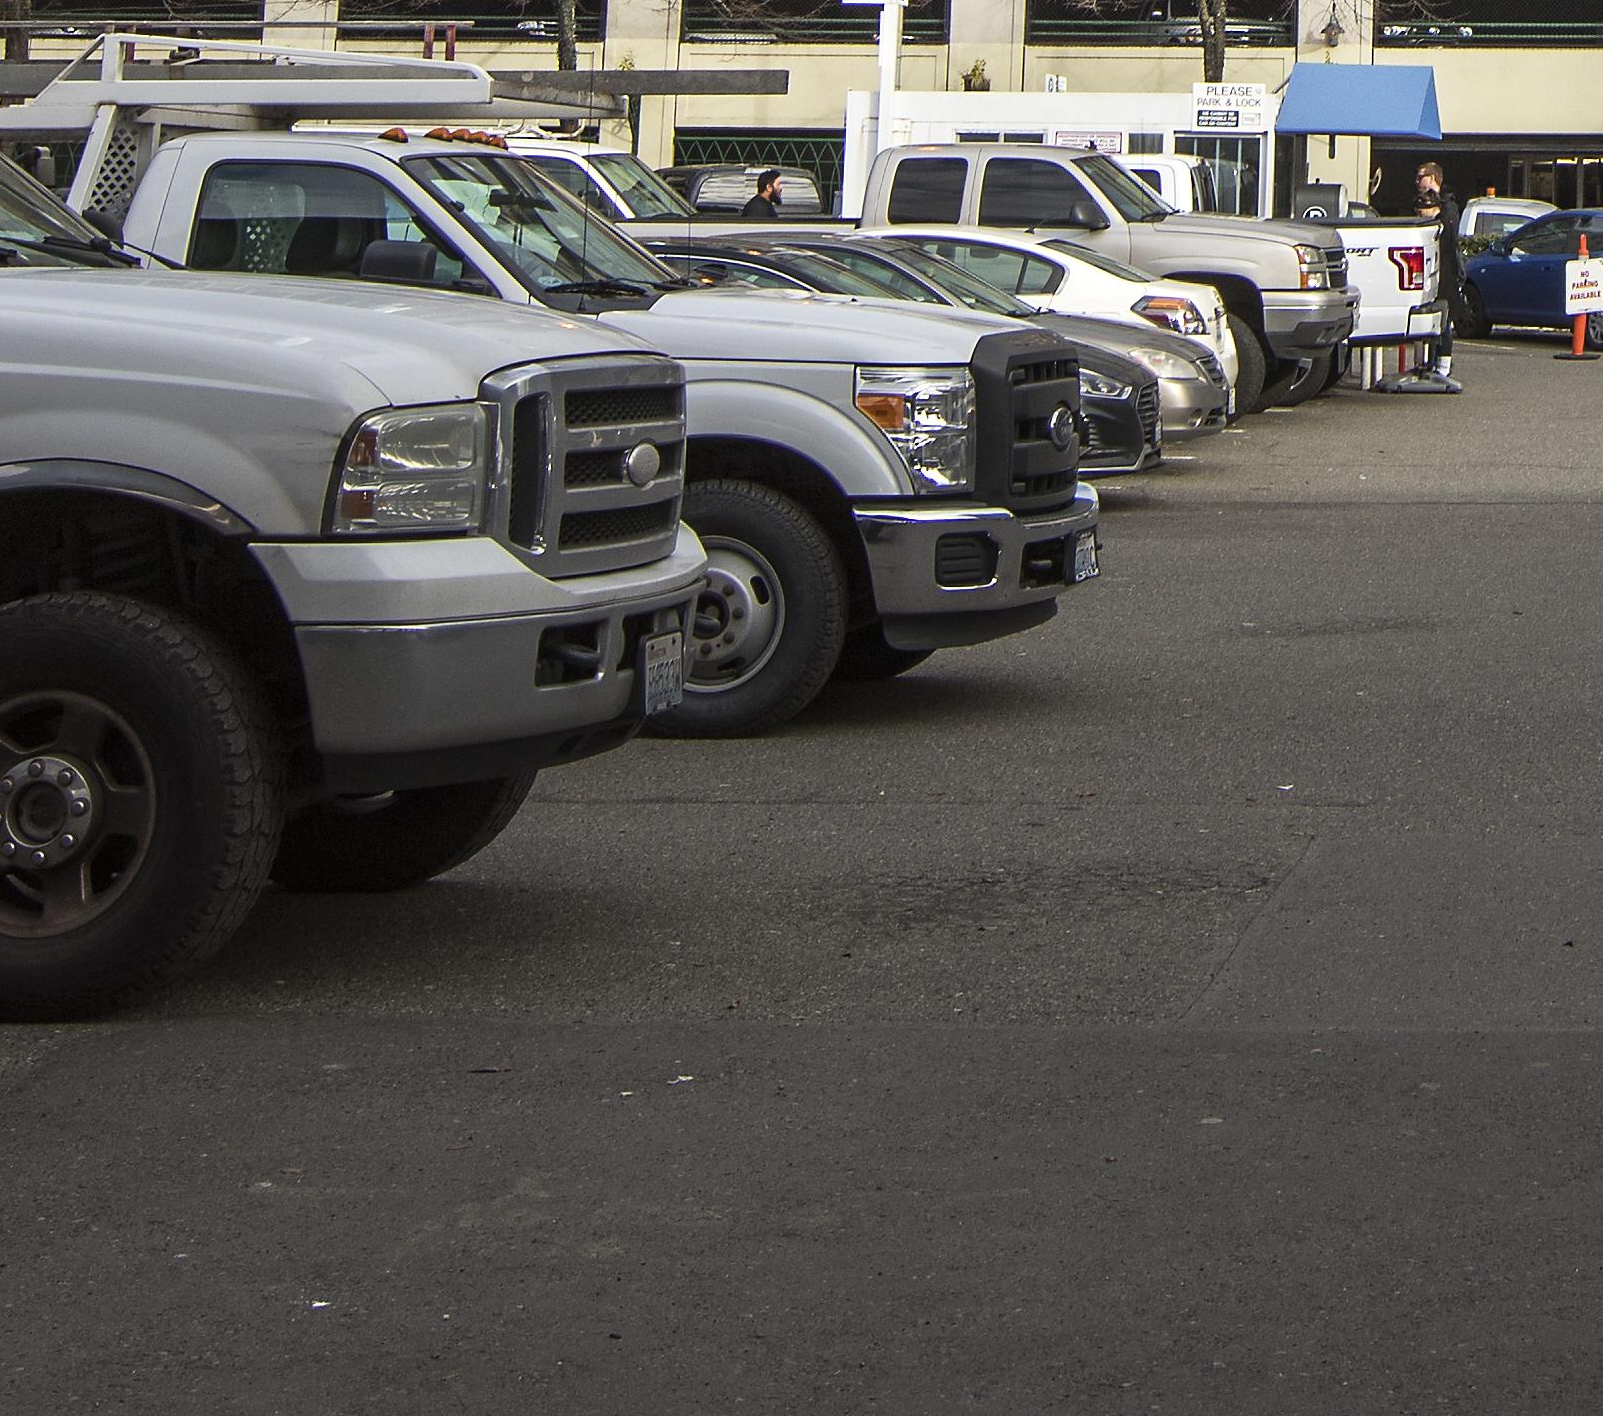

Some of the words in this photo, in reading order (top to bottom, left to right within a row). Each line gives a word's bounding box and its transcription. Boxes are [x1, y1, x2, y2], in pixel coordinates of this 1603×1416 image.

[1206, 86, 1253, 96] PLEASE
[1197, 98, 1221, 106] PARK
[1226, 98, 1232, 106] &
[1236, 98, 1261, 106] LOCK
[1572, 280, 1599, 290] PARKING
[1570, 291, 1601, 301] AVAILABLE
